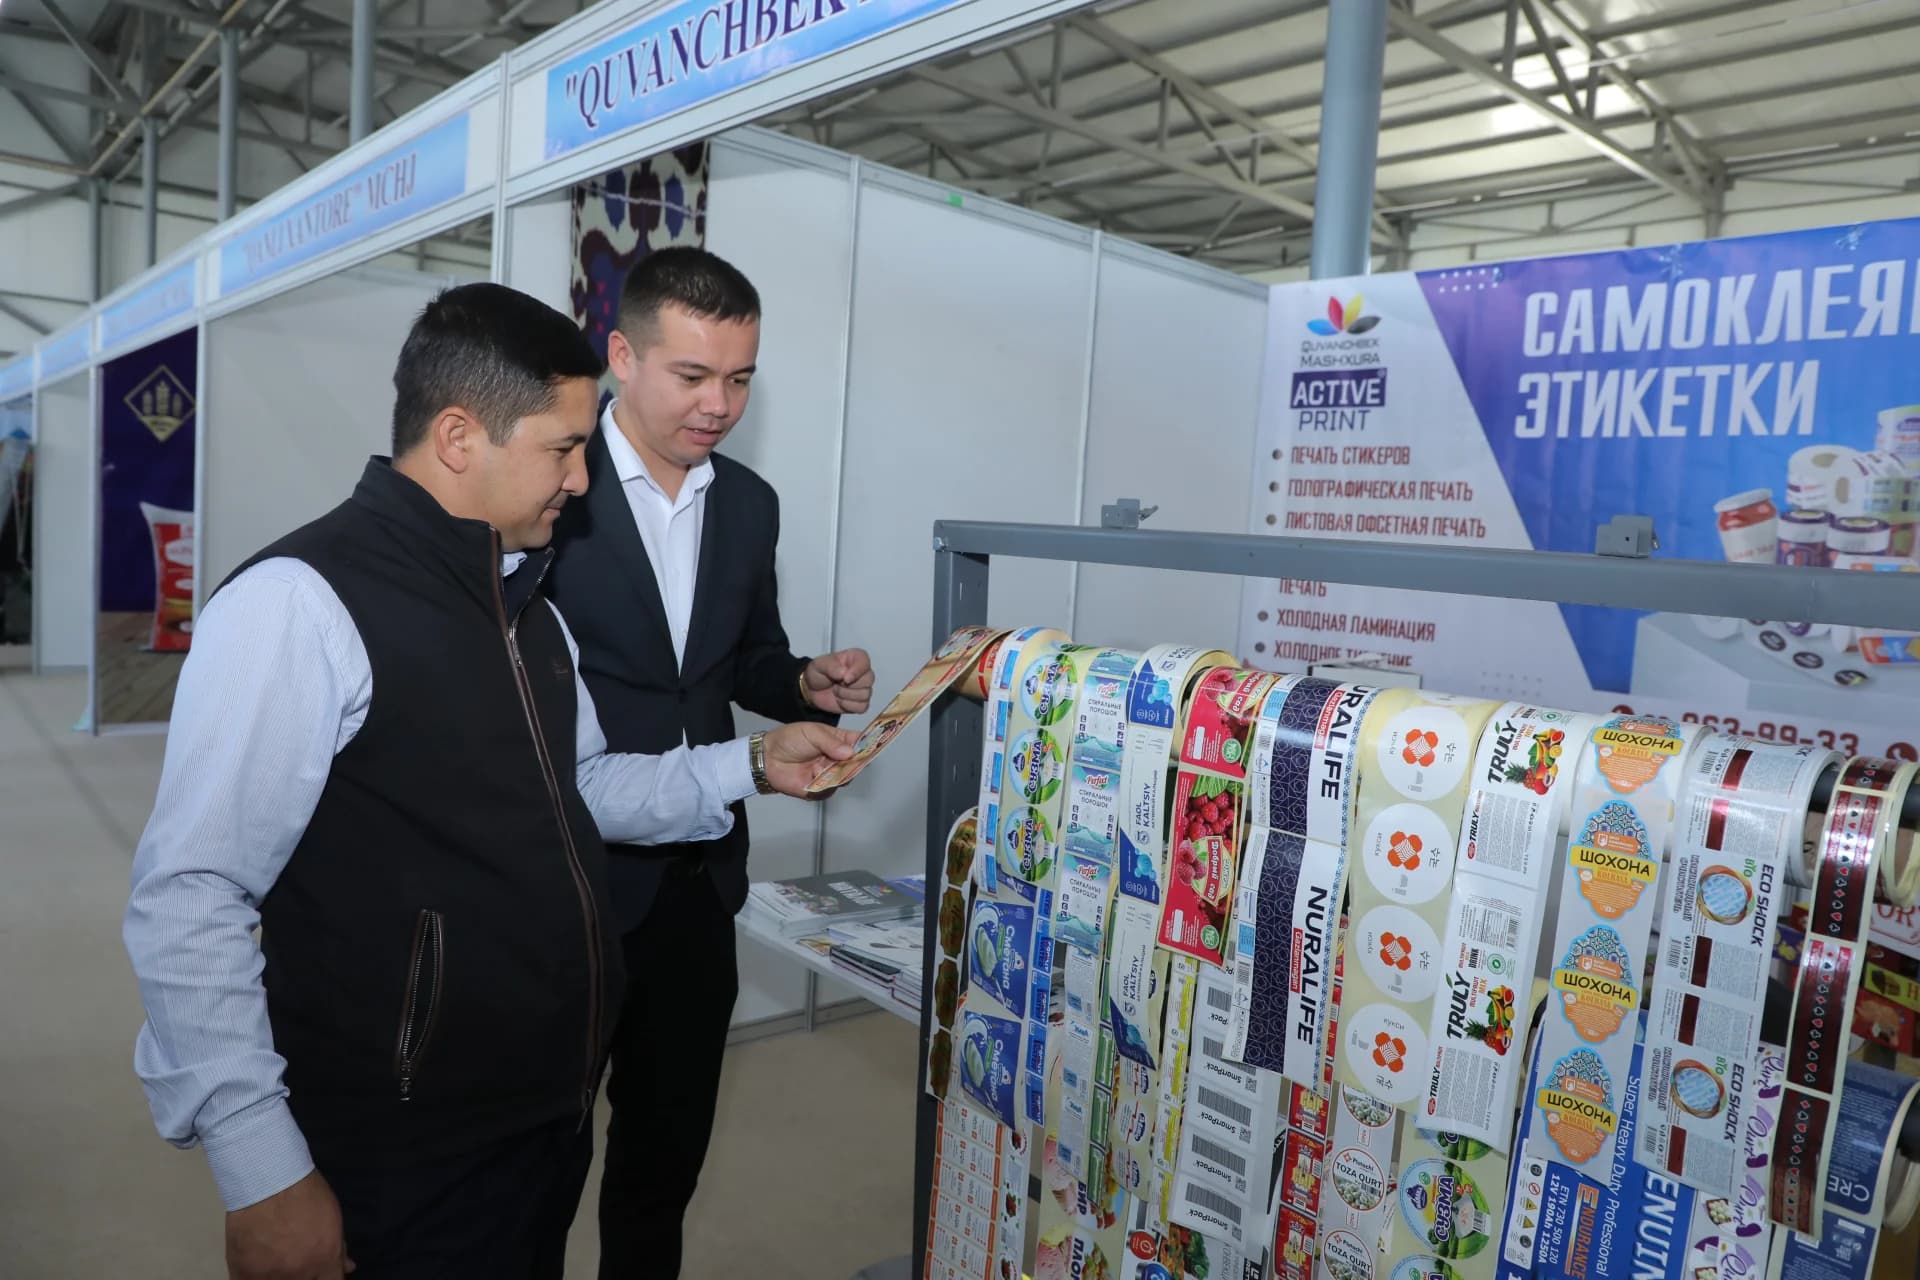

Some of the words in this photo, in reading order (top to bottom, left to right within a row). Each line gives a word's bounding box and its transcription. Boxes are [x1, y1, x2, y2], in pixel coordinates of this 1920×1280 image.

[1300, 353, 1381, 368] MASHXURA
[1293, 378, 1381, 407] ACTIVE
[1514, 360, 1820, 438] ЭТИКЕТКИ
[1298, 410, 1371, 431] PRINT
[1291, 446, 1338, 464] ПЕЧАТЬ
[1342, 446, 1410, 465] СТИКЕРОВ
[1287, 479, 1416, 500] ГОЛОГРАФИЧЕСКАЯ
[1420, 481, 1474, 501] ПЕЧАТЬ
[1356, 514, 1428, 535] ОФСЕТНАЯ
[1432, 517, 1486, 538] ПЕЧАТЬ
[1279, 578, 1327, 598] ПЕЧАТЬ
[1277, 608, 1346, 632] ХОЛОДНАЯ
[1350, 615, 1436, 643] ЛАМИНАЦИЯ
[1321, 685, 1368, 800] URALIFE
[1488, 720, 1518, 783] TRULY
[1602, 730, 1674, 750] ШОХОНА
[1028, 740, 1042, 794] СУЗМА
[1469, 810, 1481, 841] TRULY
[1023, 818, 1033, 871] СУЗМА
[1580, 849, 1650, 877] ШОХОНА
[1759, 863, 1775, 894] ECO
[1751, 896, 1769, 947] SHOCK
[1297, 886, 1328, 1045] NURALIFE
[1563, 972, 1632, 1003] ШОХОНА
[1446, 971, 1471, 1039] TRULY
[1430, 1068, 1440, 1097] TRULY
[1730, 1062, 1745, 1092] ECO
[1546, 1093, 1611, 1127] ШОХОНА
[1624, 1076, 1640, 1118] Super
[1723, 1093, 1741, 1144] SHOCK
[1616, 1118, 1635, 1163] Heavy
[1335, 1161, 1359, 1183] TOZA
[1358, 1172, 1383, 1189] QURT
[1609, 1165, 1626, 1195] Duty
[1077, 1181, 1087, 1215] БИР
[1433, 1174, 1454, 1242] СУЗМА
[1596, 1198, 1620, 1277] Professional
[1327, 1242, 1349, 1260] TOZA
[1348, 1254, 1372, 1272] QURT
